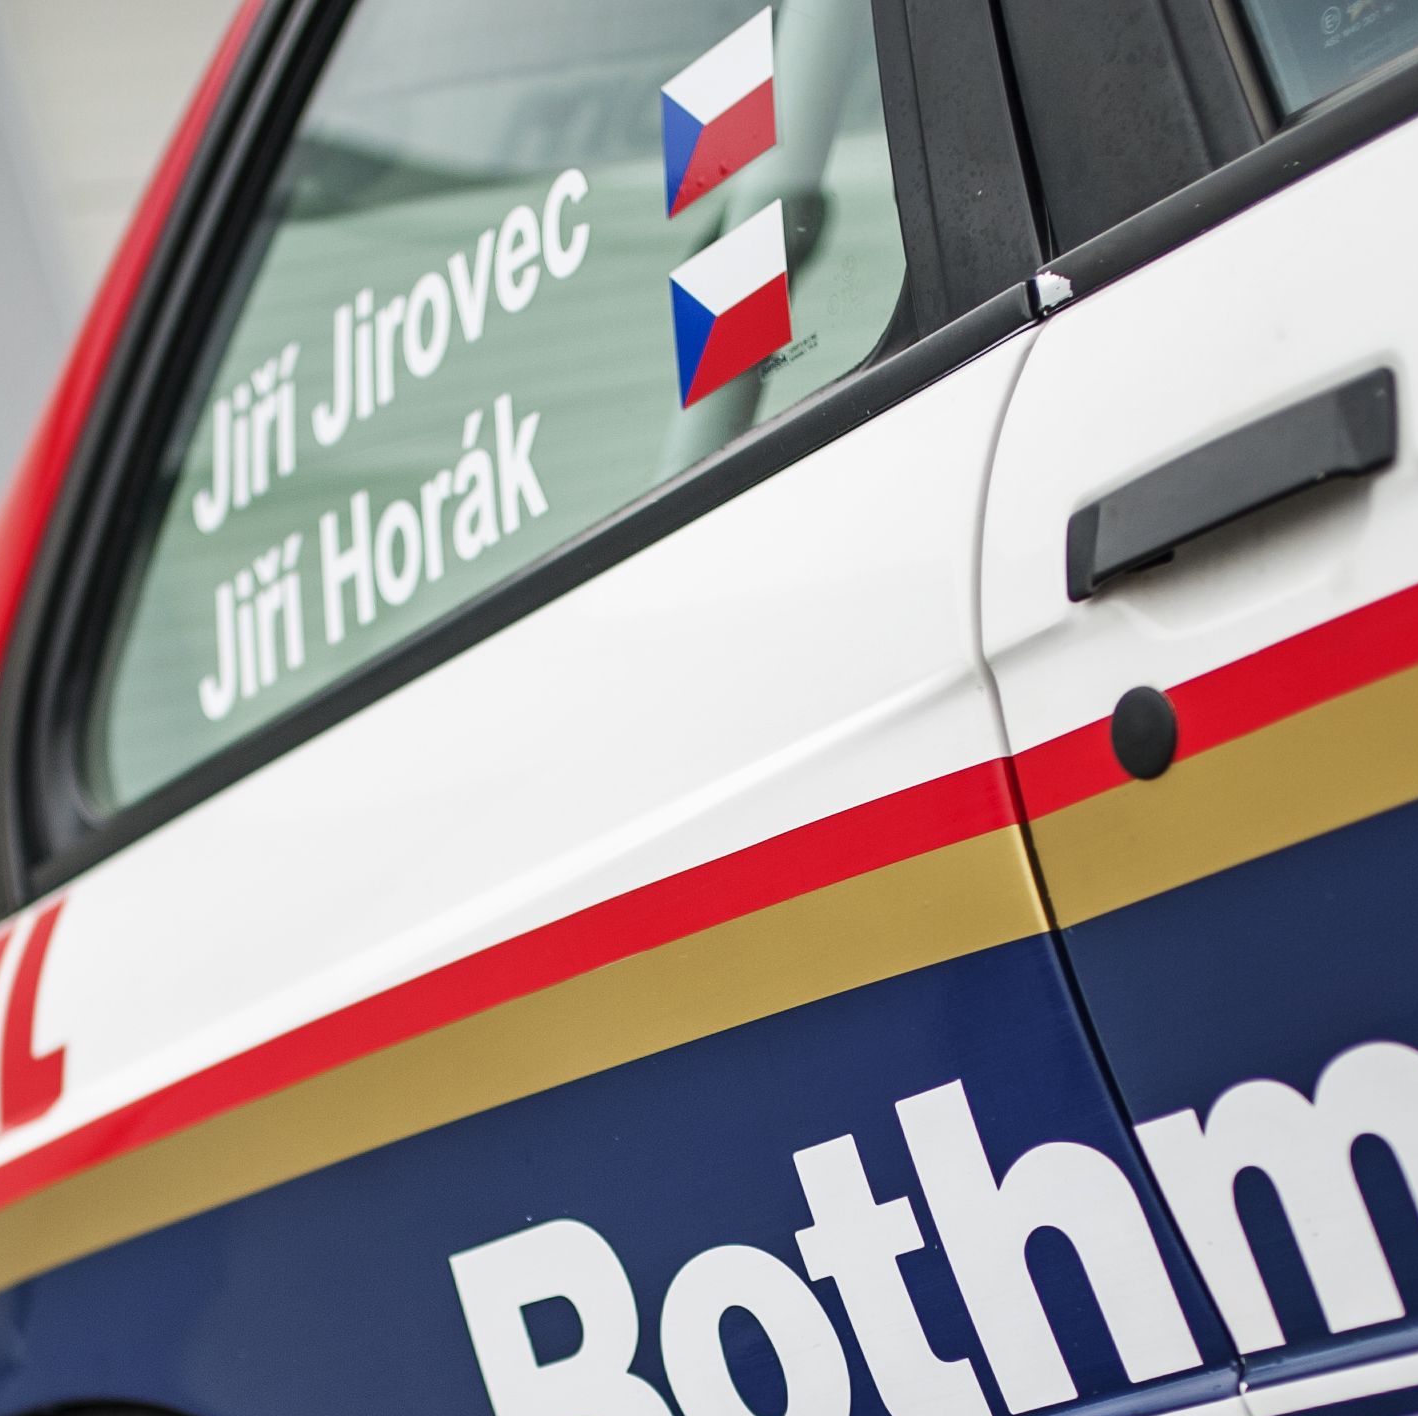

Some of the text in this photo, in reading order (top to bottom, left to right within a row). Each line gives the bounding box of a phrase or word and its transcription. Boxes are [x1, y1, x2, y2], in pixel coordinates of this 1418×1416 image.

[192, 167, 591, 534] Jiří Jirovec
[198, 393, 550, 722] Jiří Horák
